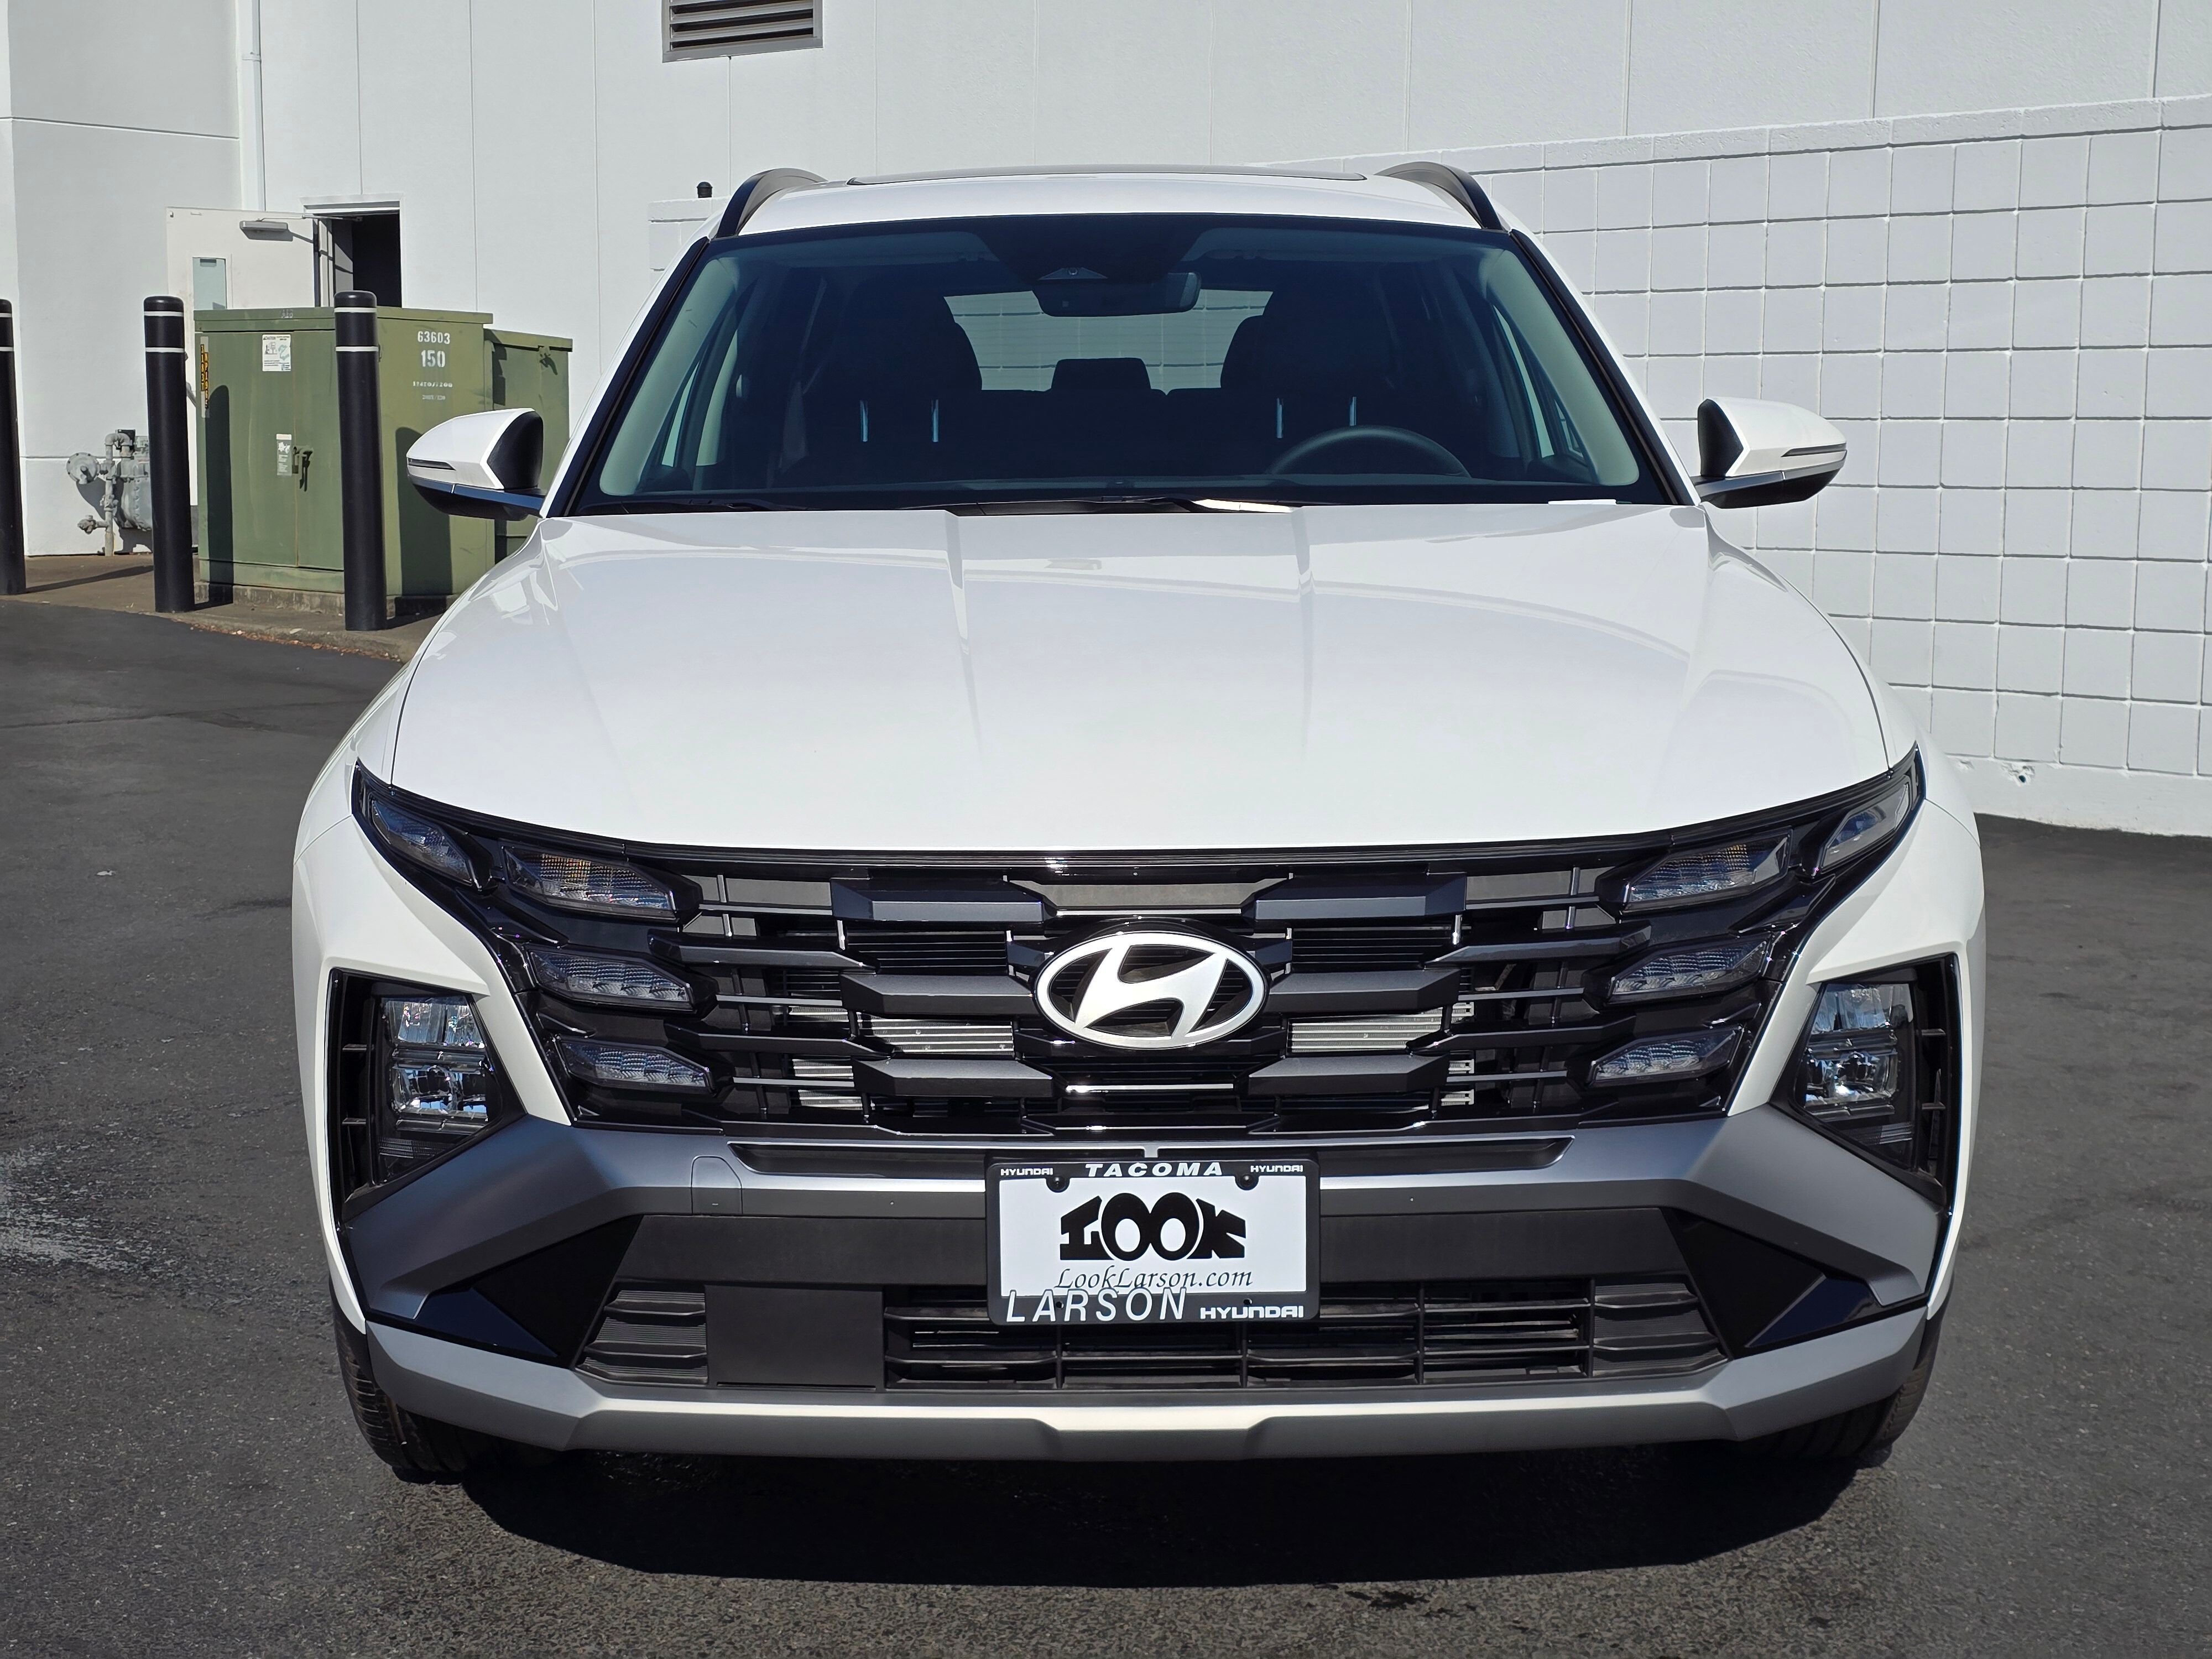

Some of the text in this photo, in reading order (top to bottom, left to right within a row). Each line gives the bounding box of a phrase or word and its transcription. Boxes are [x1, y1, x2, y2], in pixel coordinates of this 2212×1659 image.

[418, 331, 450, 345] 63603
[421, 350, 446, 367] 150
[1000, 1167, 1053, 1176] HYUNDAI
[1085, 1162, 1223, 1177] TACOMA
[1250, 1165, 1303, 1173] HYUNDAI
[1060, 1192, 1246, 1261] LOOK
[1054, 1265, 1253, 1290] LookLarson.com
[1006, 1286, 1304, 1323] LARSON HYUNDAI
